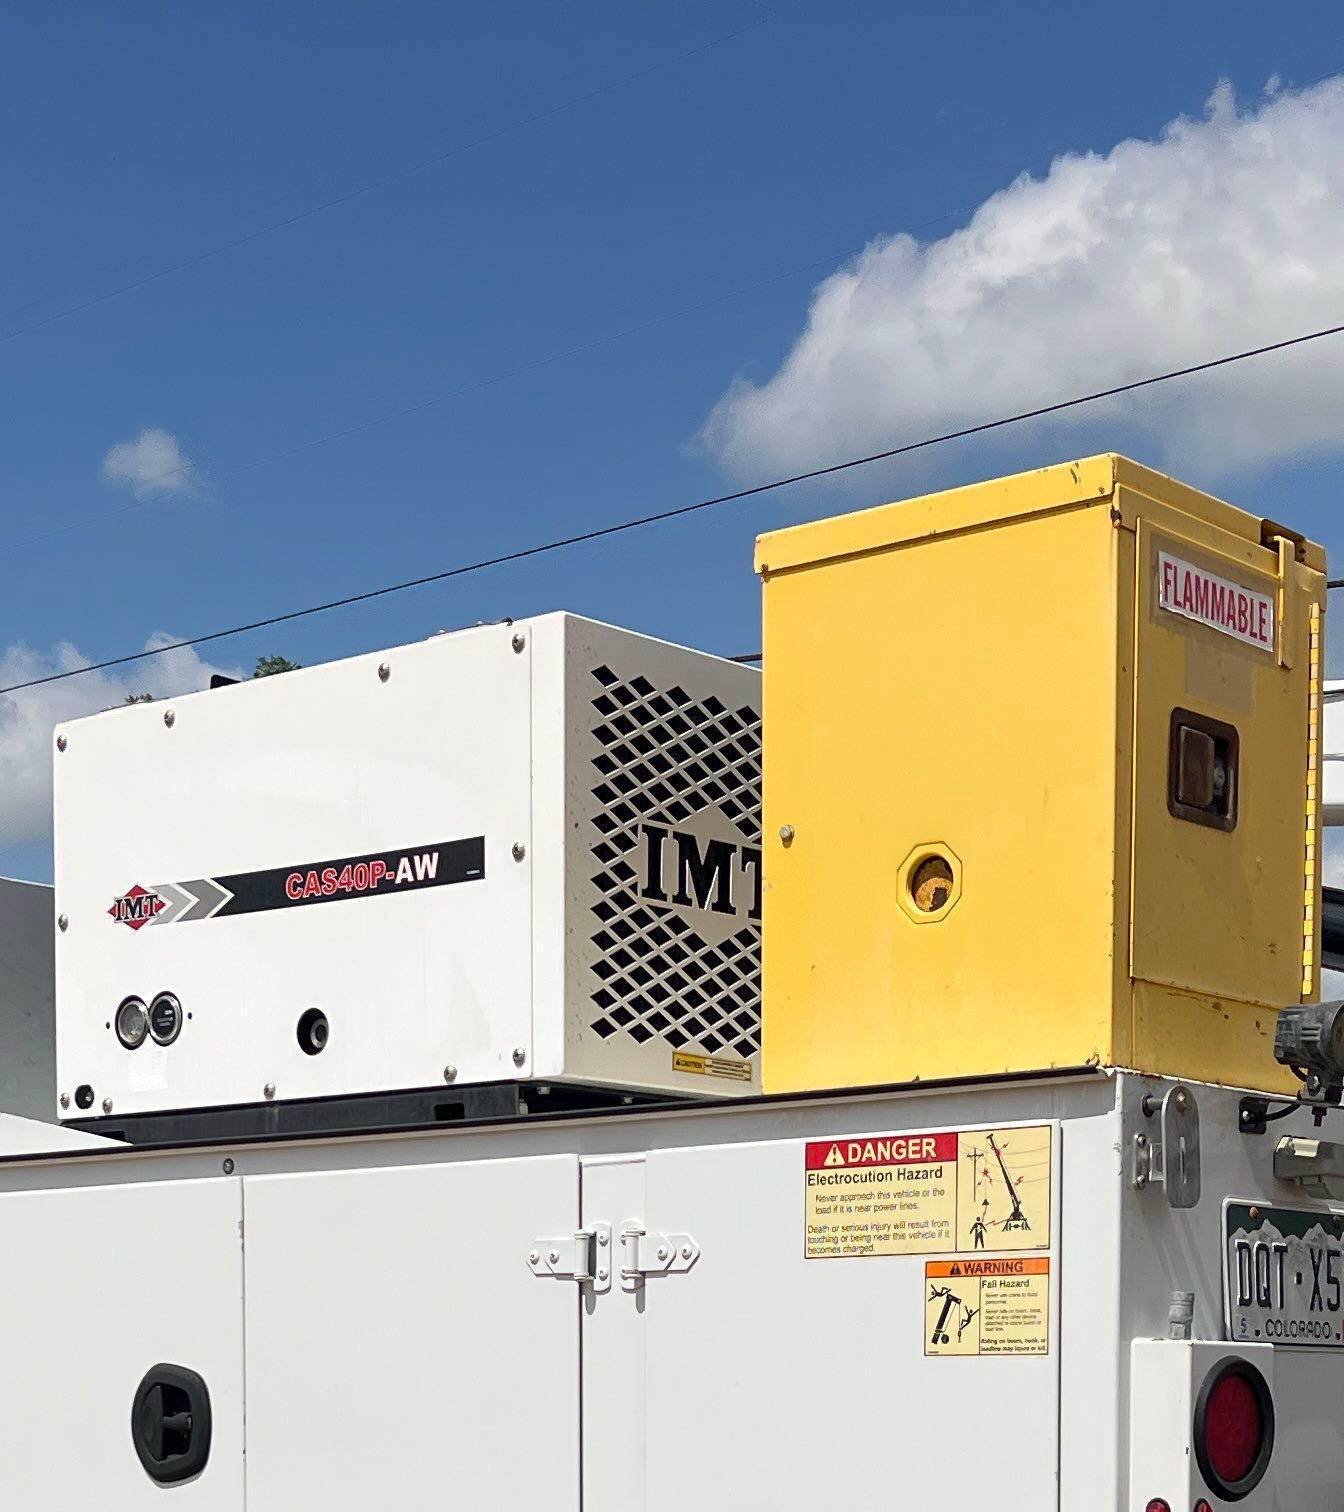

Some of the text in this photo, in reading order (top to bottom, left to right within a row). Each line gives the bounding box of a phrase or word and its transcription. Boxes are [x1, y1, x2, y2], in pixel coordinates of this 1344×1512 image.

[1164, 562, 1268, 643] FLAMMABLE
[285, 852, 439, 900] CAS40P-AW
[114, 898, 160, 922] IMT
[848, 1138, 936, 1163] DANGER
[808, 1166, 943, 1186] Electrocution Hazard
[816, 1193, 837, 1202] Never
[840, 1192, 875, 1202] approach
[877, 1191, 891, 1199] this
[893, 1190, 920, 1198] vehicle
[932, 1188, 944, 1196] the
[816, 1205, 832, 1214] load
[833, 1205, 838, 1213] if
[840, 1204, 844, 1213] it
[874, 1204, 897, 1213] power
[900, 1202, 920, 1210] lines.
[808, 1224, 829, 1233] Death
[842, 1224, 869, 1232] serious
[871, 1222, 891, 1233] injury
[908, 1220, 929, 1228] result
[931, 1219, 949, 1228] from
[808, 1235, 838, 1245] touching
[851, 1234, 871, 1244] being
[893, 1232, 906, 1240] this
[908, 1230, 936, 1239] vehicle
[808, 1244, 875, 1254] becomes charged.
[964, 1261, 1024, 1274] WARNING
[982, 1279, 1030, 1288] Fall Hazard
[1265, 1318, 1332, 1338] COLORADO
